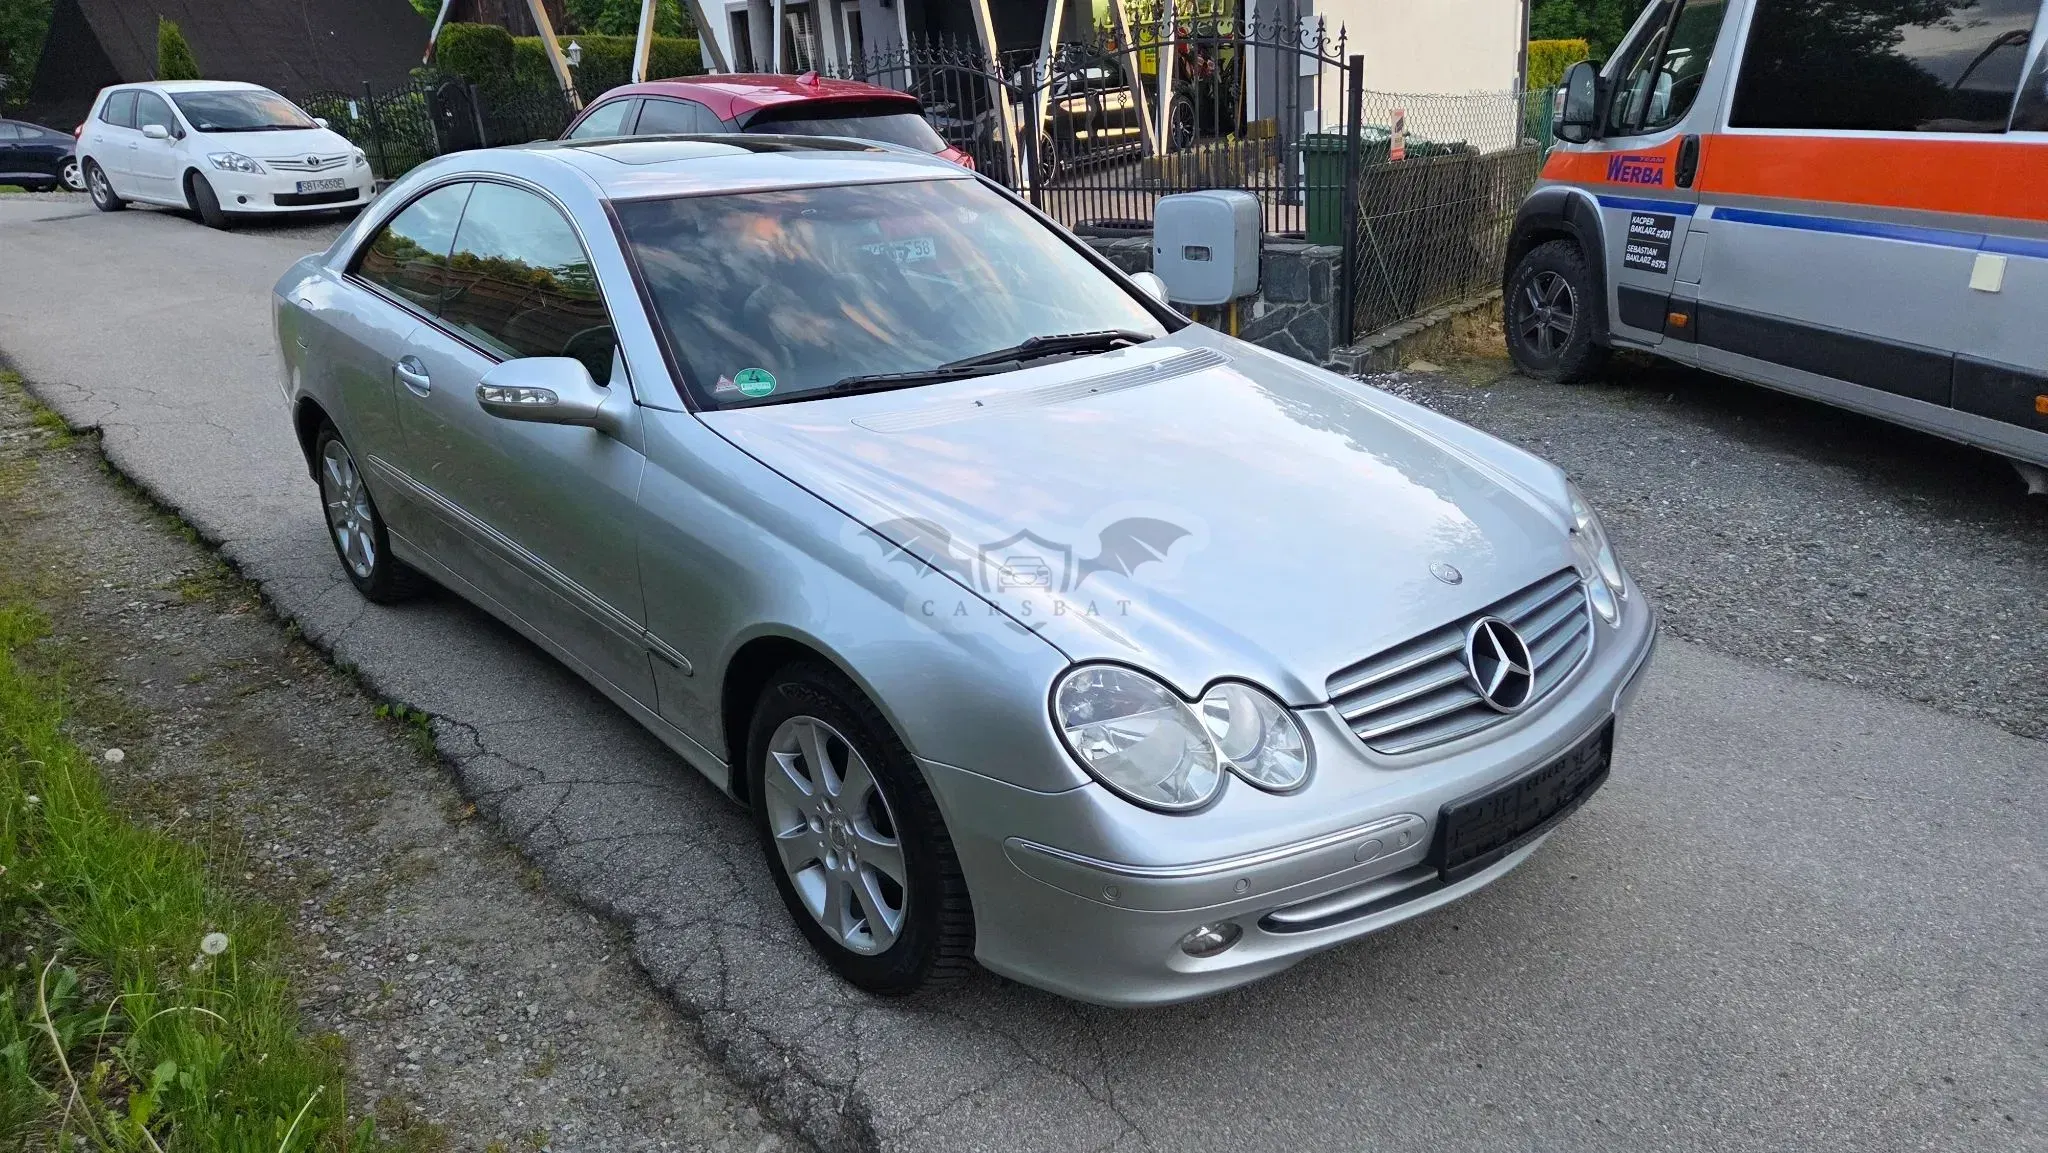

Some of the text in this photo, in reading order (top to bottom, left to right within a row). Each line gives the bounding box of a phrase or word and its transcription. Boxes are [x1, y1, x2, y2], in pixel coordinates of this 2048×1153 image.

[1607, 155, 1663, 184] WERBA
[1632, 216, 1655, 226] KACPER
[1630, 225, 1671, 239] BAKLARZ #201
[1626, 245, 1658, 256] SEBASTIAN
[1625, 253, 1667, 269] BAKLARZ #575
